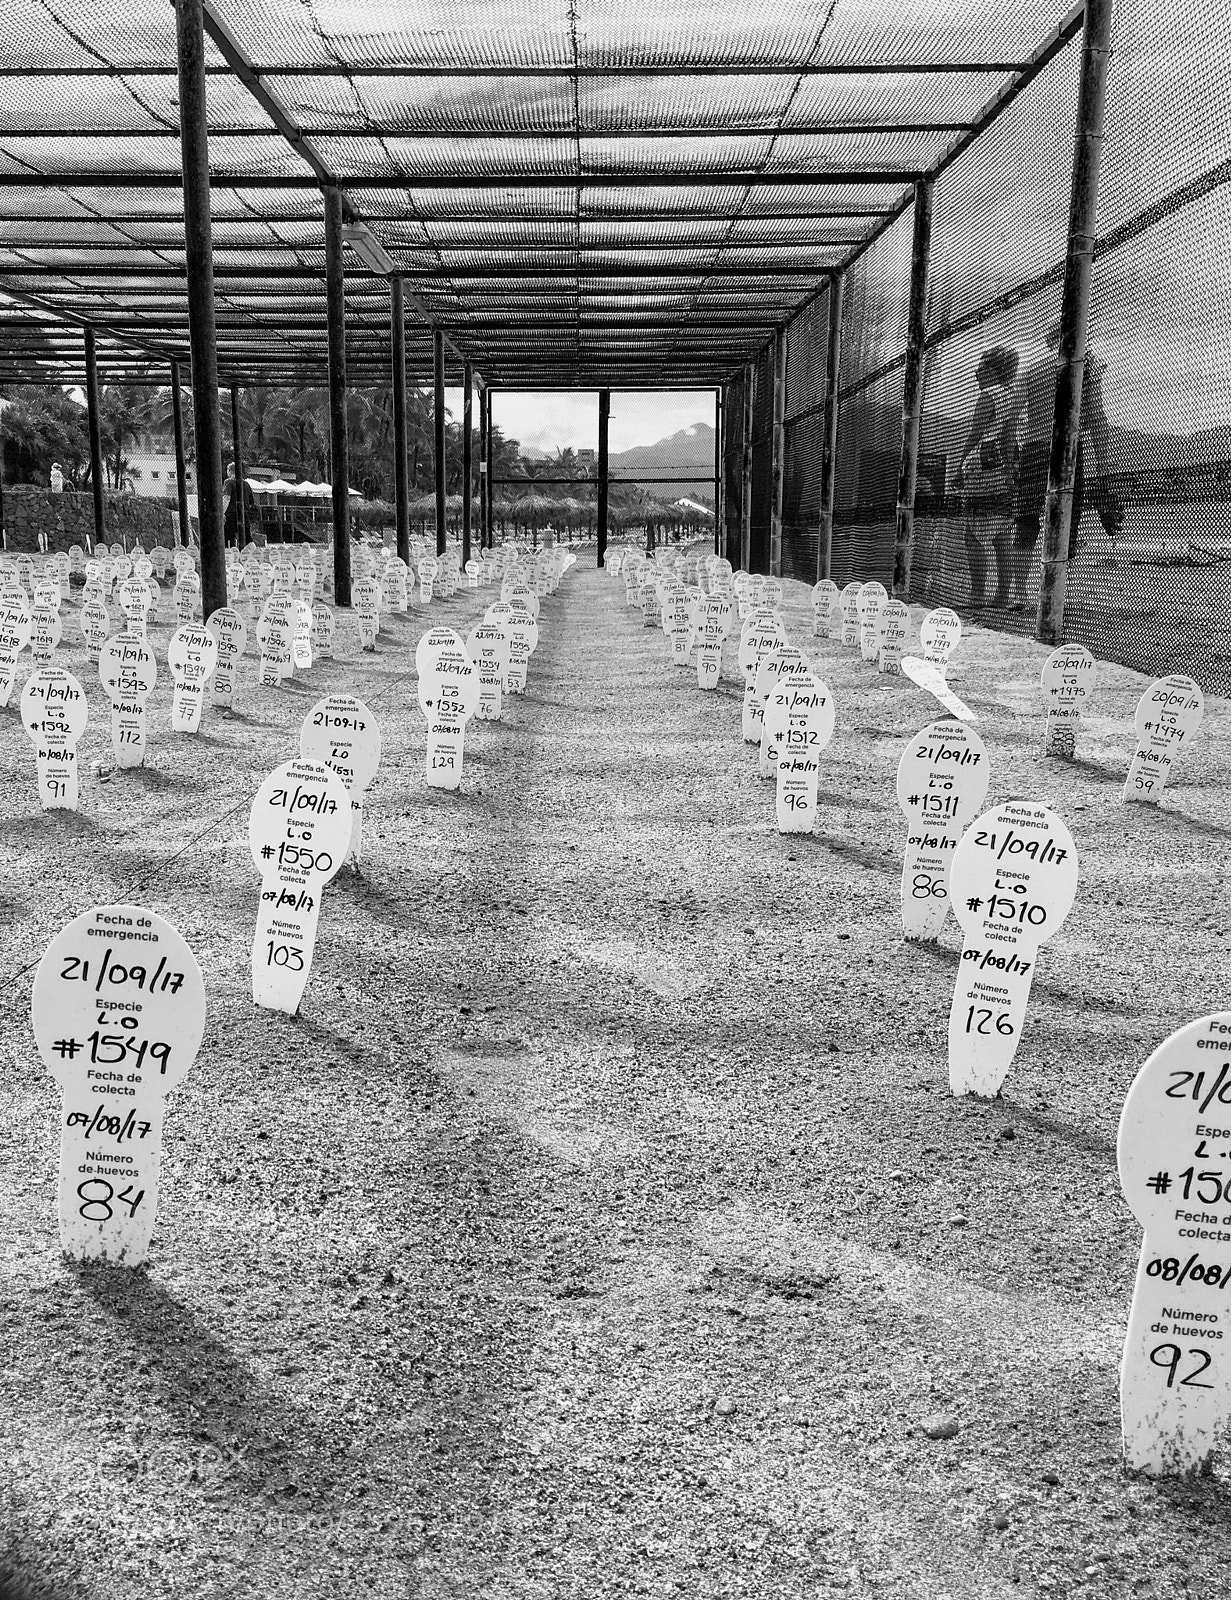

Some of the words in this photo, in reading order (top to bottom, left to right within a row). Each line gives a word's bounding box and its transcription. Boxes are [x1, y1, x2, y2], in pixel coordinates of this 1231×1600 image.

[178, 634, 213, 648] 24/09/17
[109, 646, 149, 662] 24/09/17
[174, 663, 206, 676] #1594
[702, 662, 717, 674] 90
[767, 660, 808, 676] 21/09/17
[1052, 657, 1092, 670] 20/09/17
[108, 677, 148, 691] #1593
[214, 681, 232, 693] 80
[263, 674, 278, 686] 84
[507, 679, 520, 688] 53
[30, 683, 81, 701] 24/09/17
[1050, 687, 1085, 697] #1475
[775, 692, 826, 710] 21/09/17
[1151, 690, 1199, 710] 20/09/17
[479, 702, 492, 714] 76
[30, 721, 72, 734] #1592
[313, 712, 366, 731] 21-09-17
[934, 725, 955, 734] Fecha
[957, 727, 964, 735] de
[1144, 722, 1185, 742] #1474
[120, 731, 142, 746] 112
[774, 730, 820, 745] #1512
[929, 733, 967, 742] emergencia
[39, 749, 75, 762] 10/08/17
[431, 757, 454, 768] 129
[916, 745, 981, 766] 21/09/17
[292, 763, 314, 771] Fecha
[780, 759, 817, 773] 07/08/17
[286, 771, 329, 784] emergencia
[929, 773, 954, 781] Especie
[47, 780, 65, 798] 91
[1135, 777, 1154, 793] 59
[269, 786, 337, 815] 21/09/17
[784, 794, 808, 811] 96
[907, 794, 959, 817] #1511
[921, 811, 942, 820] Fecha
[1005, 806, 1032, 817] Fecha
[1034, 809, 1046, 819] de
[287, 818, 315, 829] Especie
[923, 819, 947, 827] colecta
[997, 815, 1049, 830] emergencia
[908, 835, 957, 850] 07/08/17
[974, 831, 1068, 865] 21/09/17
[261, 842, 332, 872] #1550
[916, 857, 943, 866] Número
[278, 864, 300, 874] Fecha
[301, 867, 311, 876] de
[922, 865, 945, 873] huevos
[996, 869, 1030, 881] Especie
[280, 875, 306, 885] colecta
[912, 874, 948, 899] 86
[262, 889, 314, 912] 07/08/17
[966, 895, 1047, 925] #1510
[96, 914, 132, 926] Fecha
[137, 917, 151, 927] de
[272, 919, 301, 931] Número
[982, 921, 1009, 932] Fecha
[1011, 924, 1022, 934] de
[87, 927, 158, 942] emergencia
[267, 927, 276, 935] de
[278, 930, 303, 940] huevos
[985, 931, 1017, 943] colecta
[267, 942, 303, 971] 103
[962, 949, 1031, 977] 07/08/17
[60, 949, 184, 994] 21/09/17
[974, 982, 1008, 995] Número
[967, 990, 976, 999] de
[978, 993, 1012, 1006] huevos
[96, 999, 142, 1012] Especie
[965, 1006, 1014, 1036] 126
[52, 1031, 171, 1074] #1549
[87, 1070, 123, 1082] Fecha
[127, 1073, 141, 1083] de
[92, 1084, 135, 1096] colecta
[66, 1105, 152, 1143] 07/08/17
[86, 1151, 133, 1164] Número
[78, 1163, 92, 1174] de
[97, 1165, 139, 1178] huevos
[77, 1180, 145, 1221] 84
[1175, 1210, 1218, 1224] Fecha
[1178, 1226, 1231, 1241] colecta
[1161, 1307, 1218, 1322] Número
[1150, 1321, 1165, 1334] de
[1169, 1324, 1224, 1339] huevos
[1149, 1343, 1214, 1389] 92
